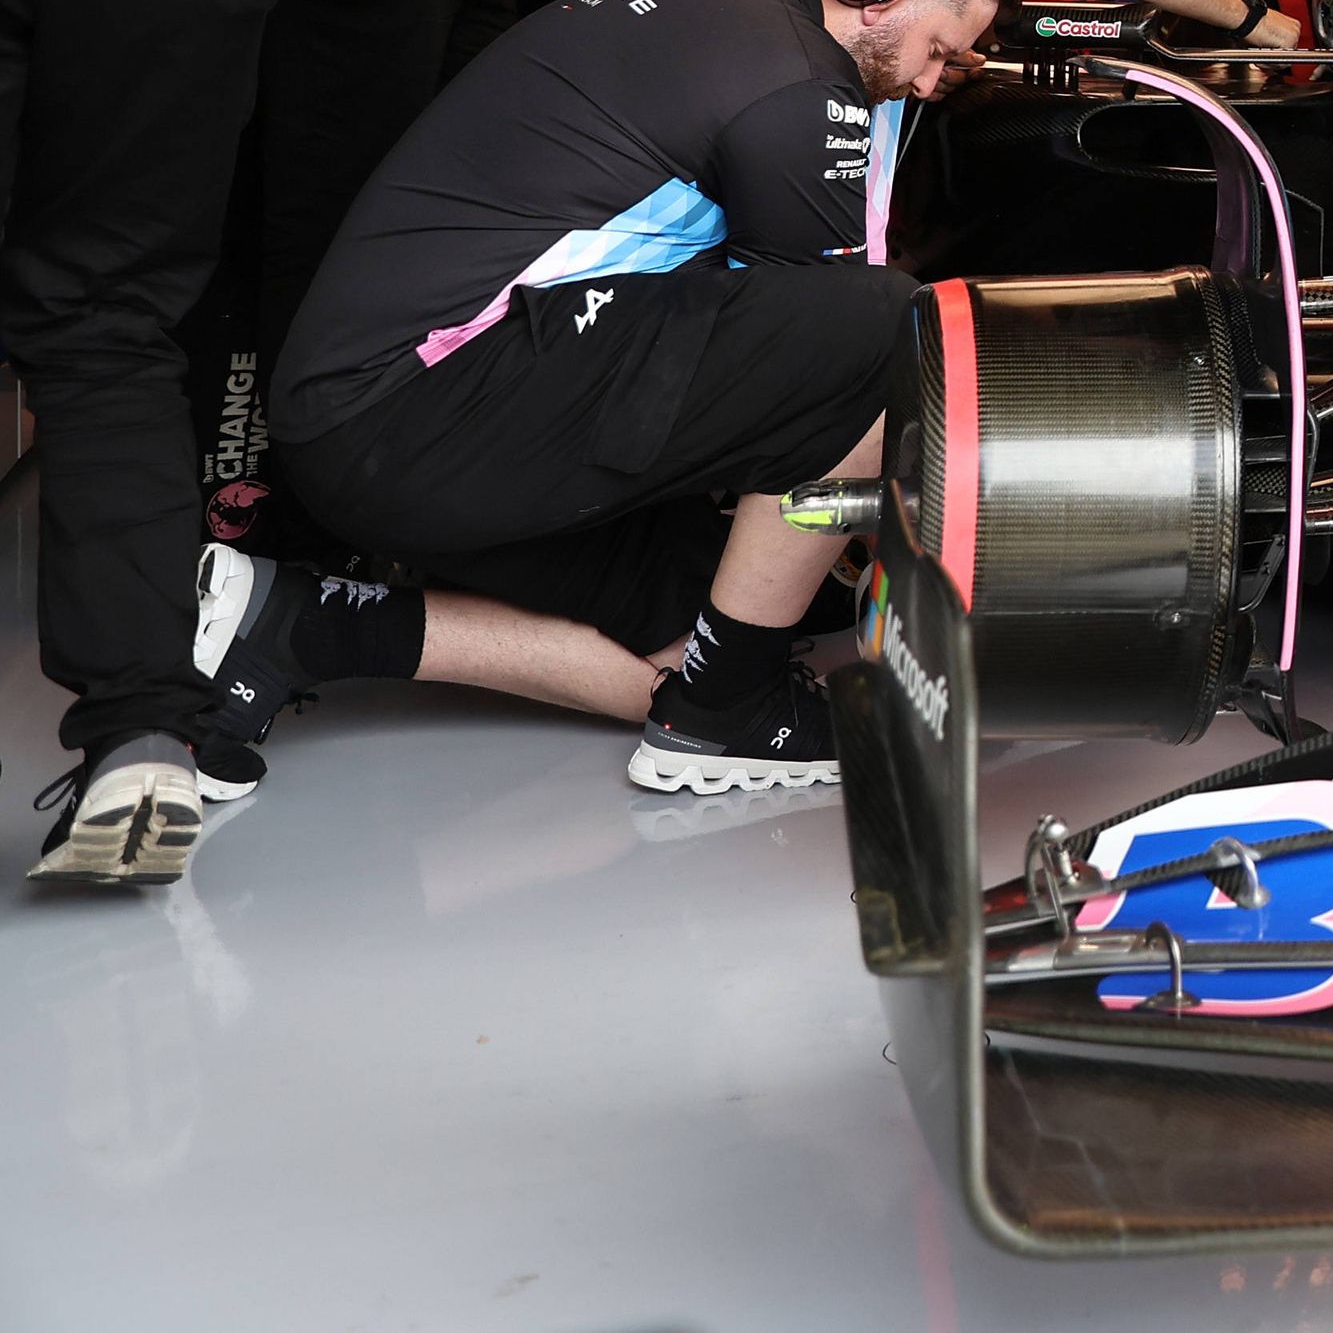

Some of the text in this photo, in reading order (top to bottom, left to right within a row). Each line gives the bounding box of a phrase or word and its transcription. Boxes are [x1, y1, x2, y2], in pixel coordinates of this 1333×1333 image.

[1056, 20, 1122, 39] Castrol
[216, 352, 257, 480] CHANGE
[246, 453, 259, 478] THE
[883, 602, 949, 740] Microsoft
